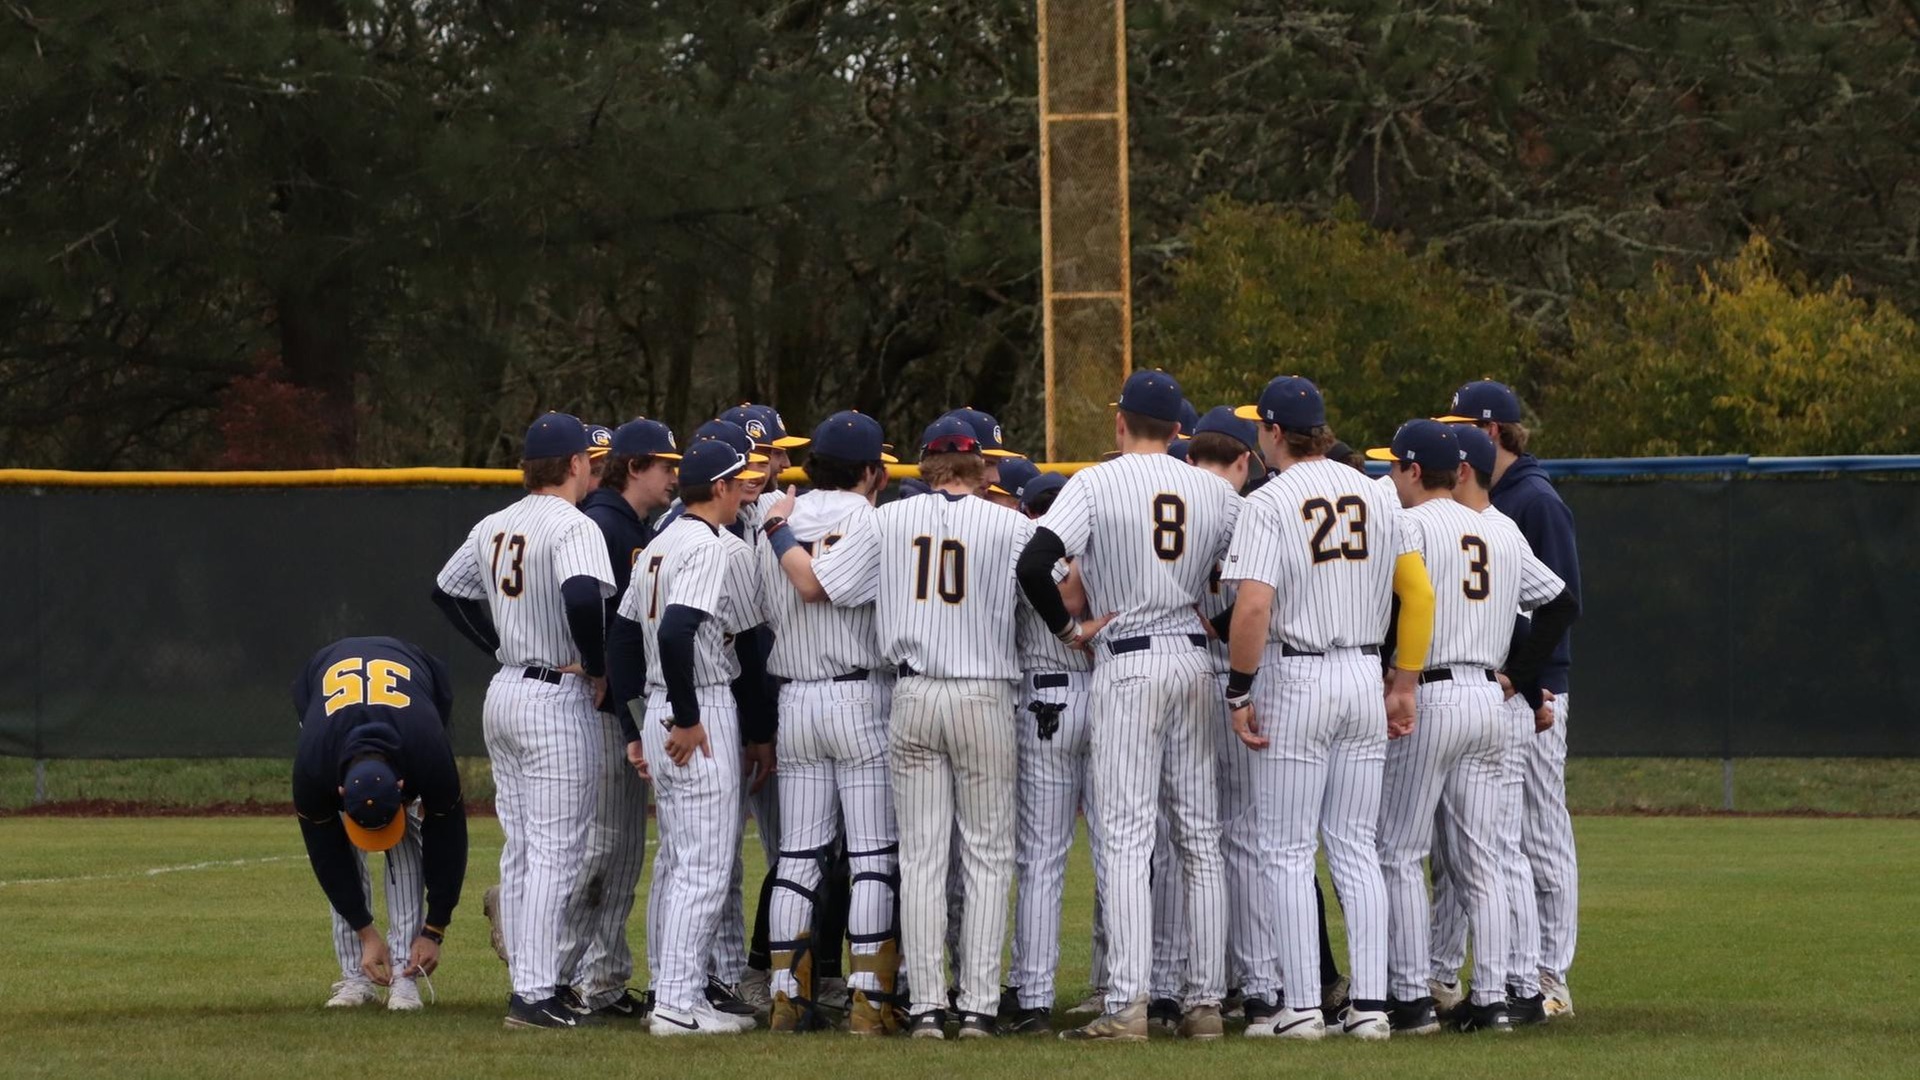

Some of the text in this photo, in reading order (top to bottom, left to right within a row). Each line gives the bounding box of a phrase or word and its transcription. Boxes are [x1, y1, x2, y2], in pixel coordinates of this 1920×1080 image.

[1152, 491, 1186, 562] 8
[1302, 494, 1369, 565] 23
[493, 531, 526, 599] 13
[647, 554, 664, 620] 7
[913, 534, 966, 605] 10
[1460, 533, 1490, 601] 3
[322, 657, 411, 717] 35
